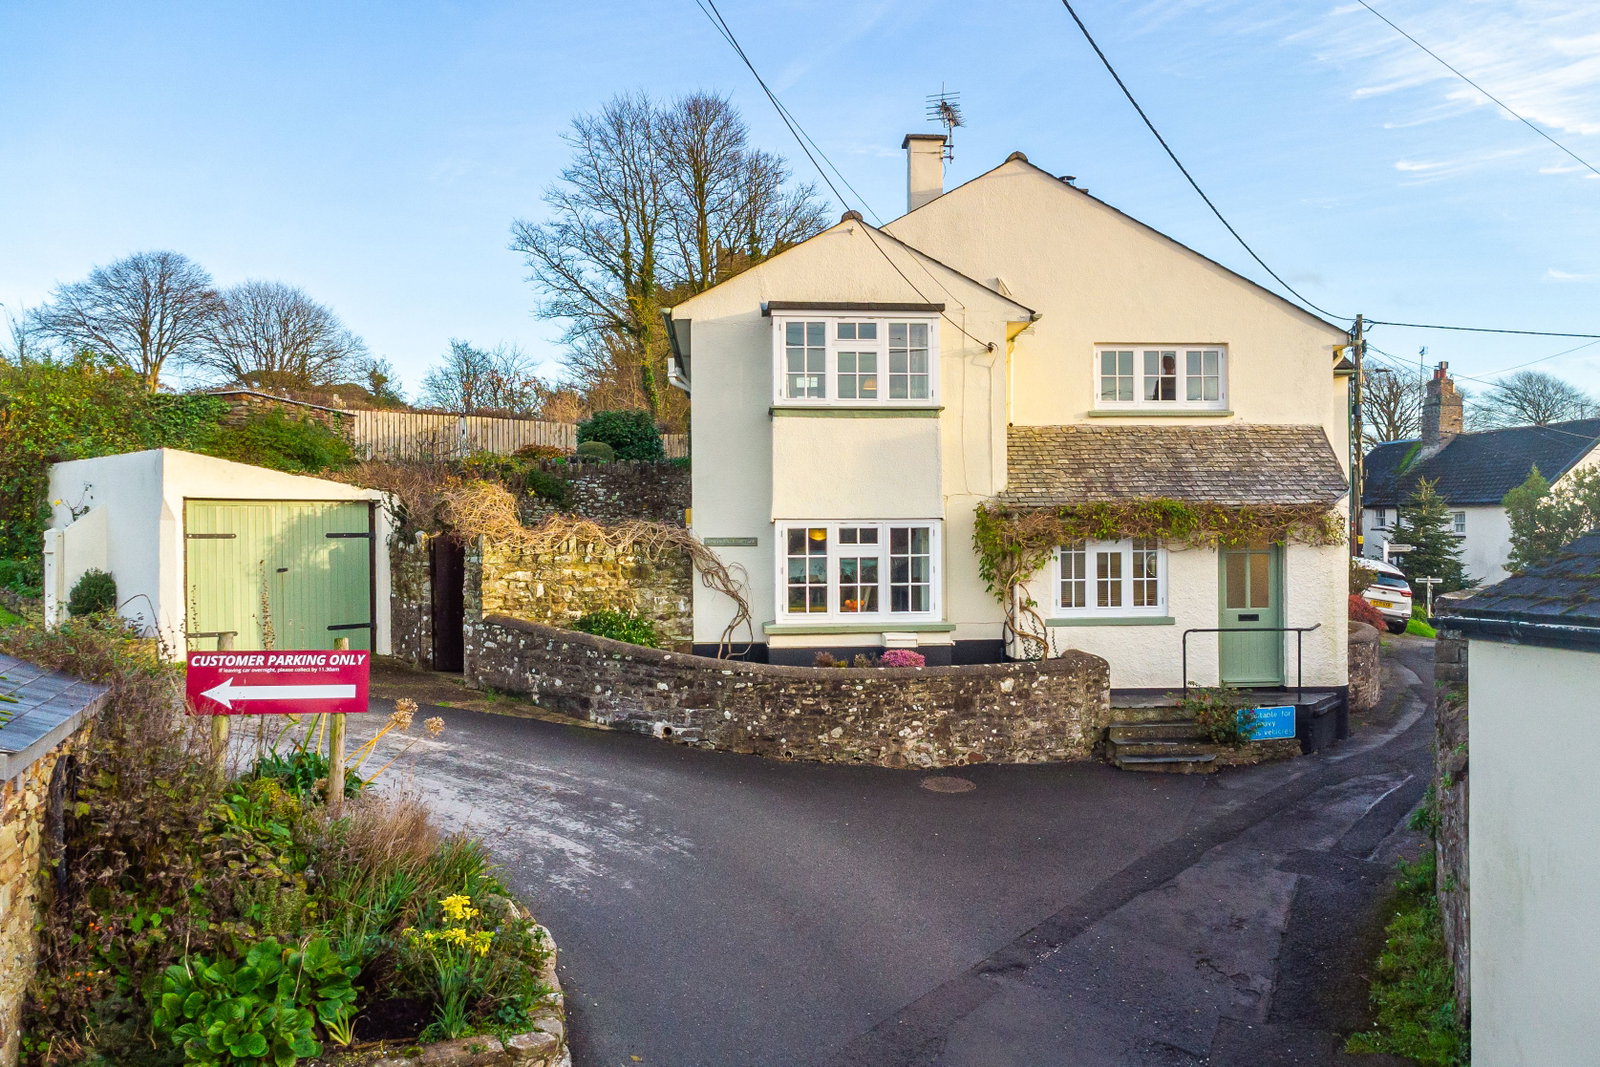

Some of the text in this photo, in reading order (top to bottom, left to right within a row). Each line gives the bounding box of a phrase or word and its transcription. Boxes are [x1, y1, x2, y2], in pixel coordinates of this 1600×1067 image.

[191, 654, 367, 667] CUSTOMER PARKING ONLY
